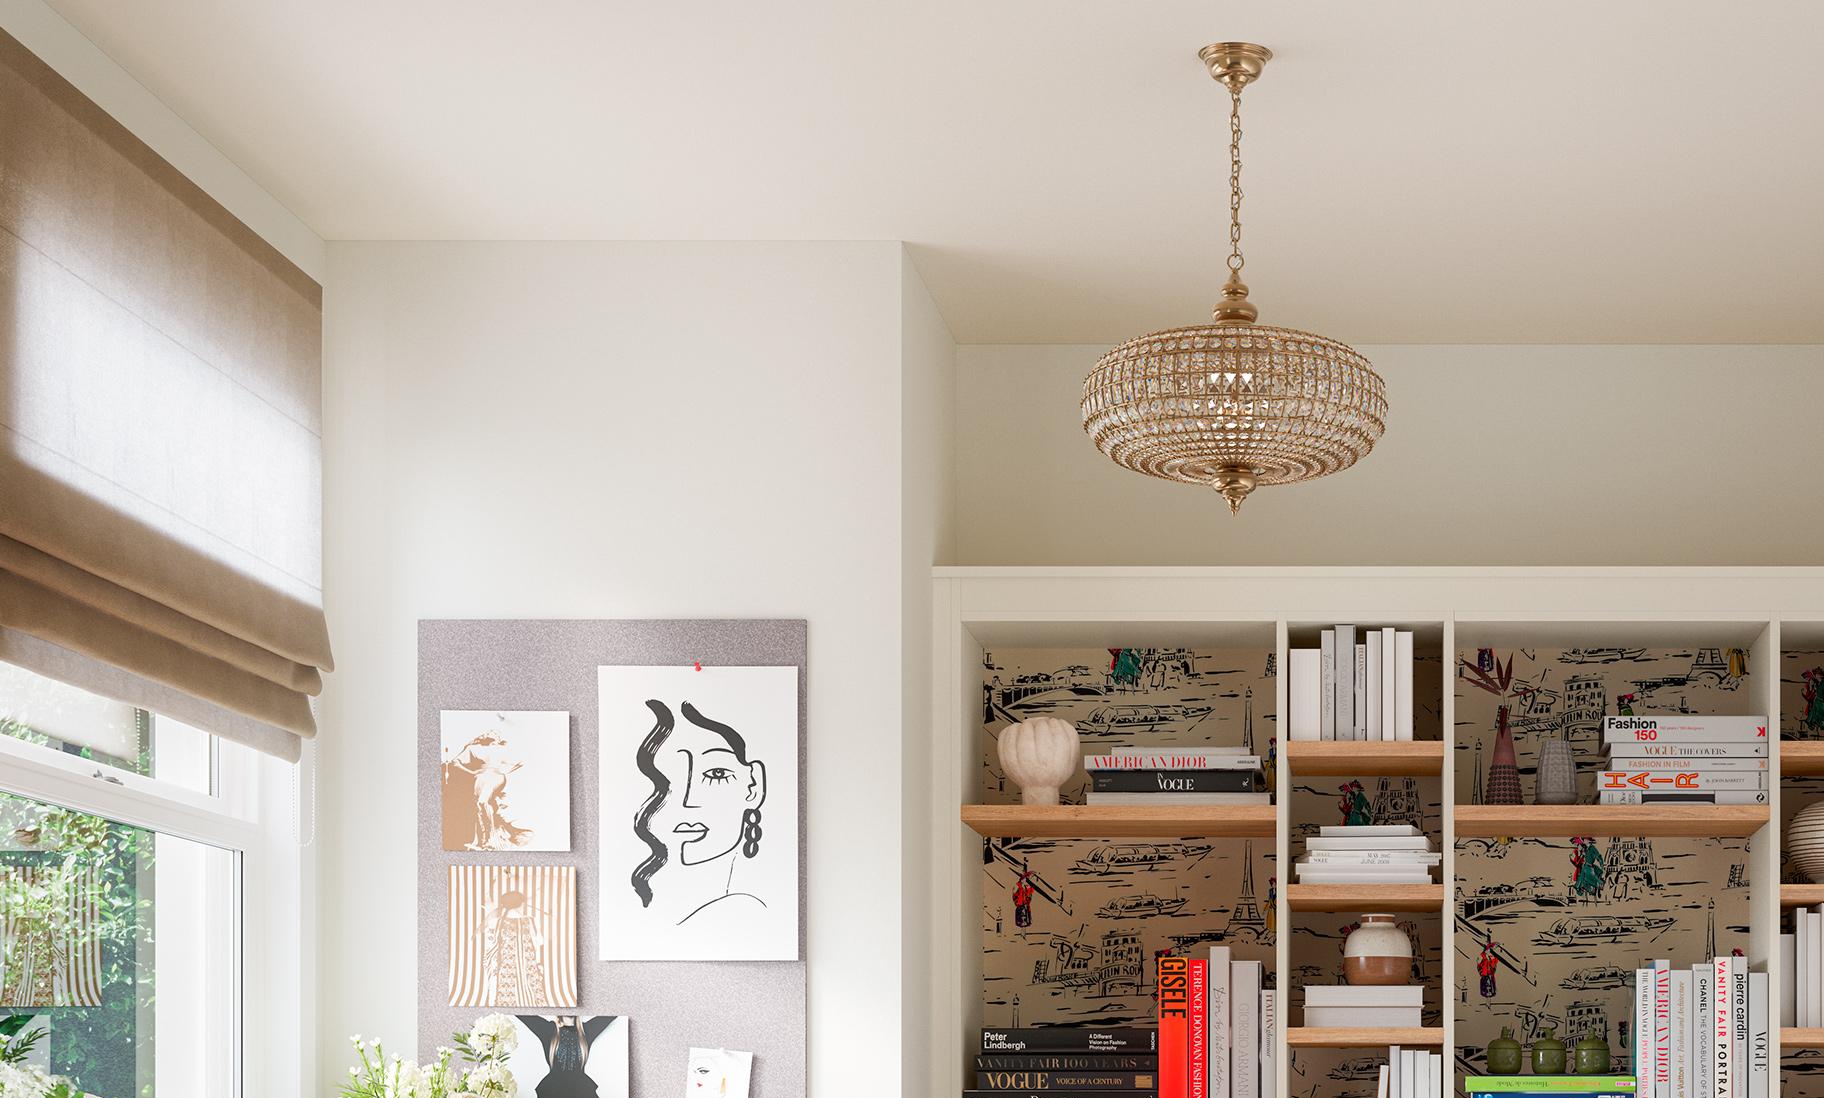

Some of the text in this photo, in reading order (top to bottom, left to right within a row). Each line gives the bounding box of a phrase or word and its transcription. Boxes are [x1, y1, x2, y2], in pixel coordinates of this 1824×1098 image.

[1608, 718, 1657, 729] Fashion
[1634, 730, 1657, 741] 150
[1645, 746, 1678, 755] VOGUE
[1093, 756, 1207, 769] AMERICAN DIOR
[1157, 778, 1194, 791] VOGUE
[1604, 772, 1700, 789] HAIR
[1160, 959, 1187, 1020] GISELE
[1192, 963, 1203, 1012] TERENCE
[1717, 961, 1726, 1004] VANITY
[1699, 978, 1707, 1013] CHANEL
[1265, 994, 1273, 1030] ITALIAN
[1734, 973, 1747, 1041] pierre cardin
[1657, 969, 1669, 1083] AMERICAN DIOR
[1717, 1010, 1726, 1037] FAIR
[984, 1032, 1008, 1041] Peter
[984, 1040, 1026, 1051] Lindbergh
[1192, 1014, 1203, 1062] DONOVAN
[1238, 1002, 1250, 1096] GIORGIO ARMANI
[1754, 1031, 1767, 1072] VOGUE
[977, 1058, 1026, 1068] VANITY
[1029, 1058, 1059, 1068] FAIR
[1093, 1058, 1137, 1068] YEARS
[986, 1072, 1123, 1090] VOGUE VOICE OF A CENTURY
[1700, 1080, 1707, 1090] OF
